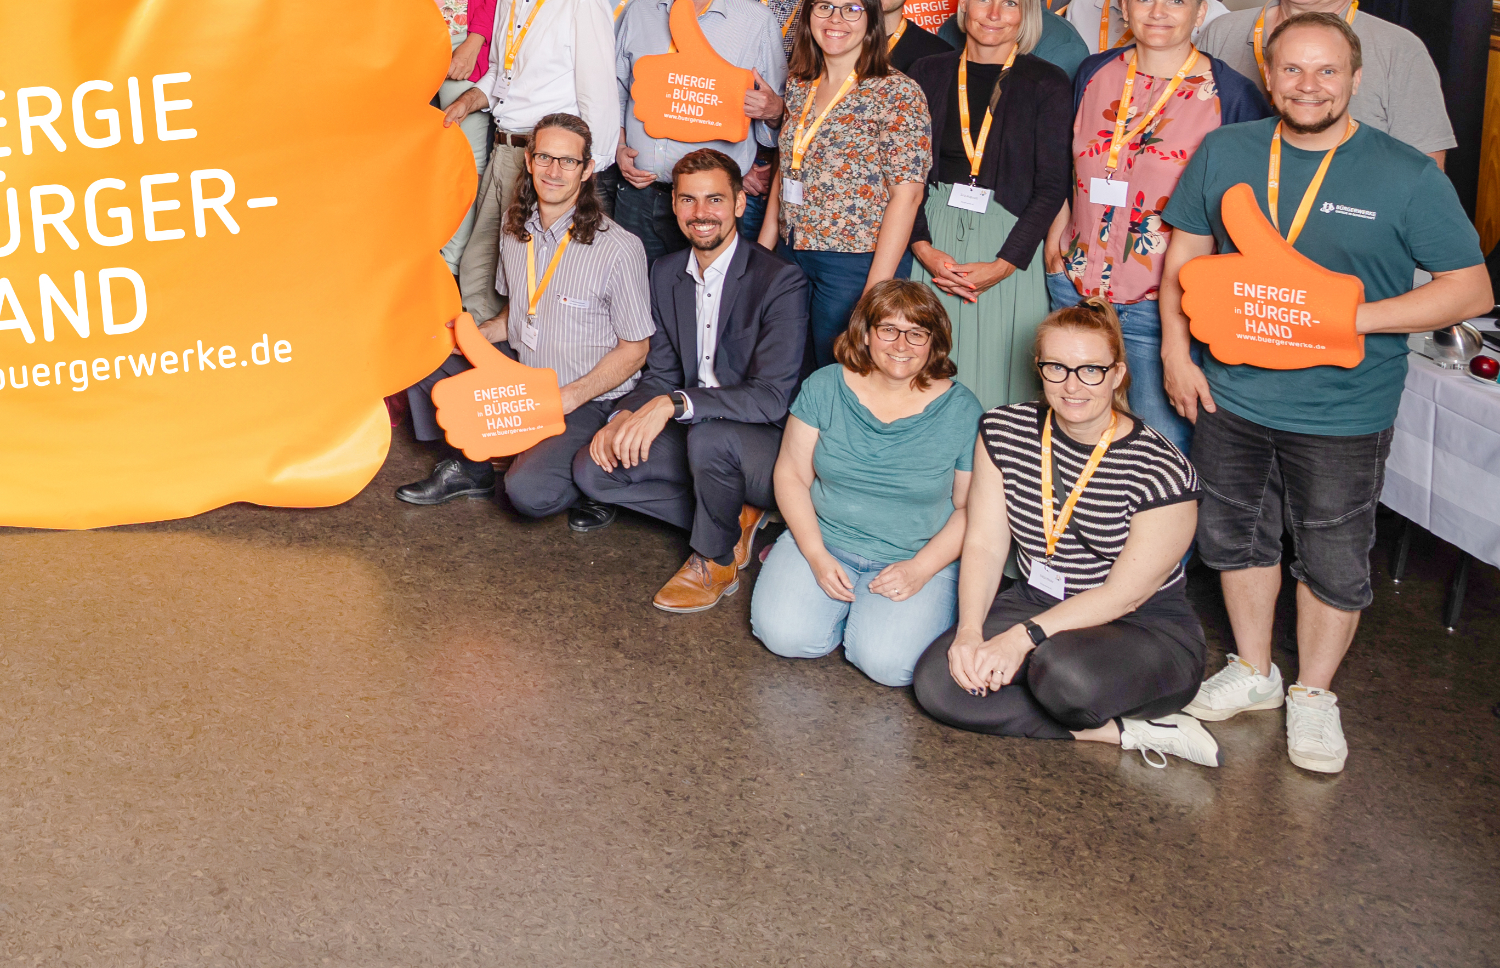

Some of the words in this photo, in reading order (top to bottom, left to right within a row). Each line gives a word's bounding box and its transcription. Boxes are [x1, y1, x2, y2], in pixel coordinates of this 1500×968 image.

[902, 0, 951, 15] NERGIE
[668, 72, 717, 91] ENERGIE
[672, 87, 724, 107] BÜRGER-
[671, 101, 704, 117] HAND
[1233, 281, 1307, 305] ENERGIE
[1234, 306, 1242, 314] in
[1244, 300, 1321, 328] BÜRGER-
[1244, 318, 1293, 340] HAND
[1236, 333, 1326, 350] www.buergerwerke.de
[473, 383, 528, 402] ENERGIE
[483, 398, 541, 417] BÜRGER-
[486, 415, 522, 431] HAND
